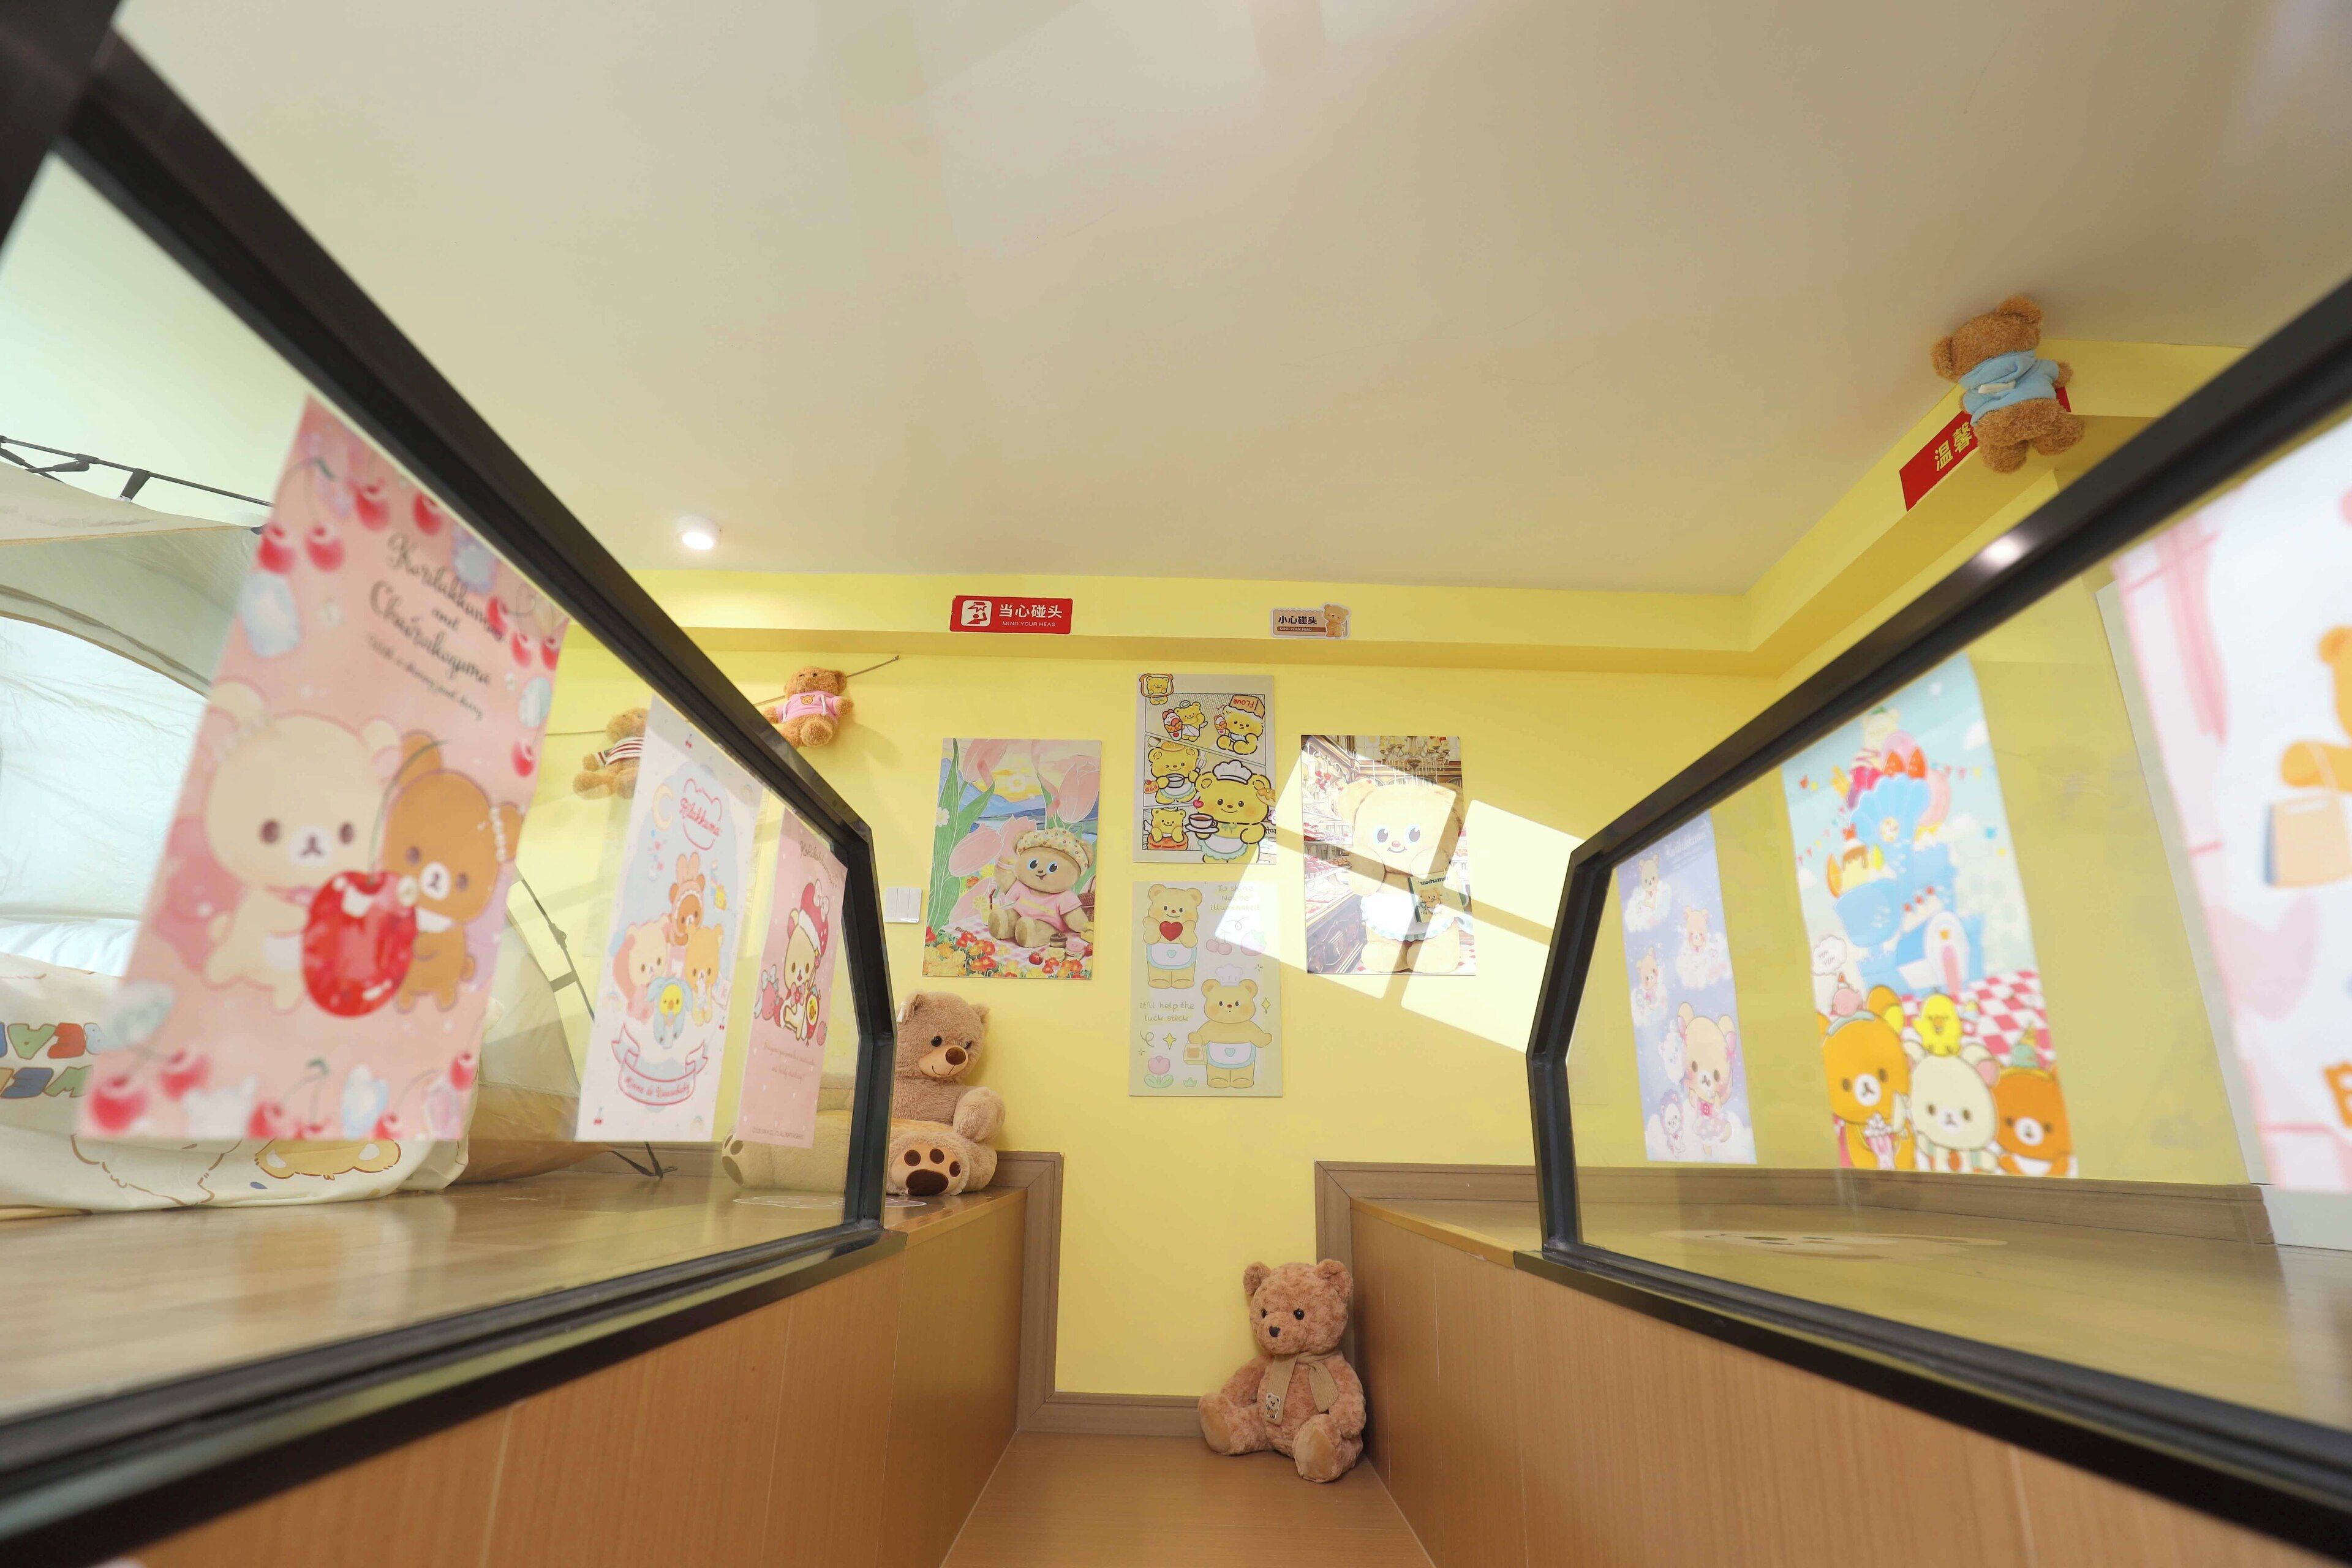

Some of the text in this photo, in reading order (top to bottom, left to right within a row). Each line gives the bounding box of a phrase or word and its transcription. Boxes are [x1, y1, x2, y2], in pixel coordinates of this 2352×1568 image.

[999, 603, 1063, 619] 当心碰头
[1278, 616, 1317, 625] 小心碰头
[1233, 698, 1255, 708] FLOUR
[1159, 1001, 1178, 1013] help
[1180, 1001, 1195, 1009] the
